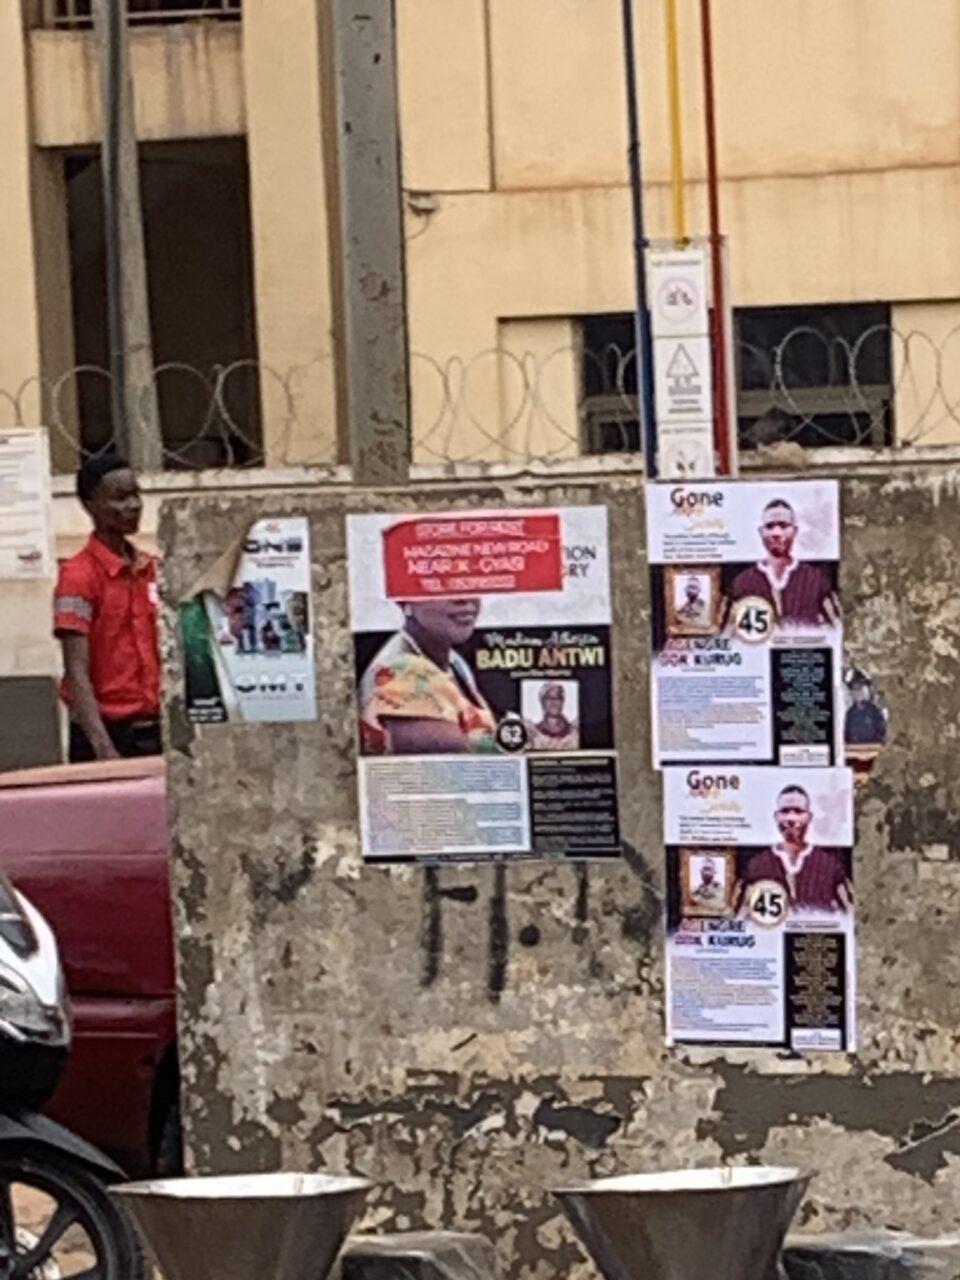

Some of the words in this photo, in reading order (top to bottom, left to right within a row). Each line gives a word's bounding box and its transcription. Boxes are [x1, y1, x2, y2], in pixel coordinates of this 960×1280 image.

[670, 487, 724, 509] Gone
[739, 609, 769, 634] 45
[475, 647, 534, 670] BADU
[538, 647, 605, 668] ANTWI
[686, 768, 741, 791] Gone
[754, 893, 783, 917] 45
